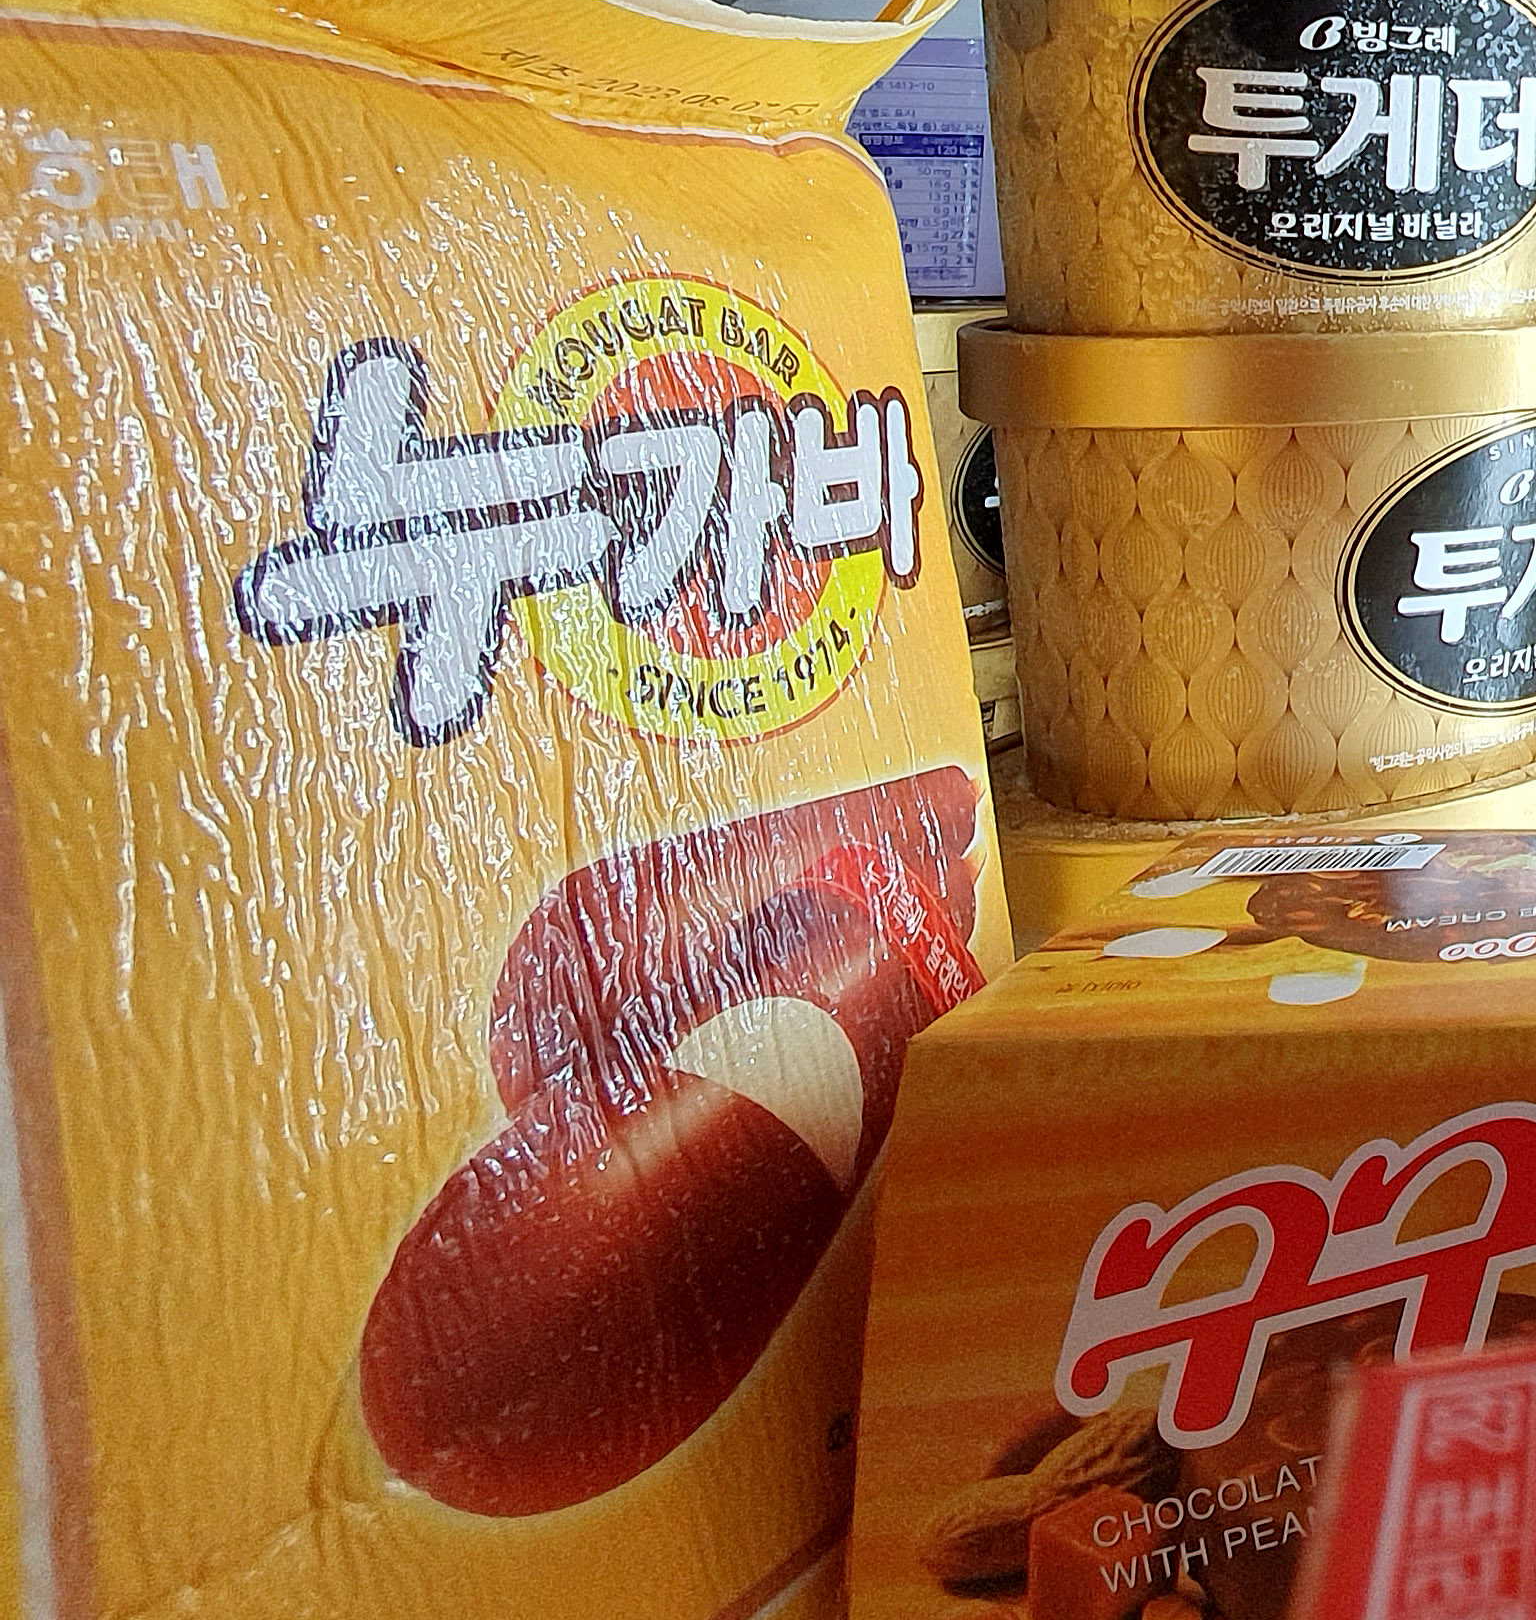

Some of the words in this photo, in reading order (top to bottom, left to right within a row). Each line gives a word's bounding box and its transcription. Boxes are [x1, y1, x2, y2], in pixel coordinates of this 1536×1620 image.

[1351, 19, 1456, 55] 빙그레
[1267, 212, 1396, 241] 오리지널
[1401, 211, 1483, 240] 바닐라
[720, 301, 800, 388] BAR
[236, 336, 924, 746] 누가바
[627, 661, 766, 719] SINCE
[1384, 909, 1507, 932] CREAM
[1092, 1455, 1325, 1548] CHOCOLAT
[1098, 1535, 1209, 1594] WITH
